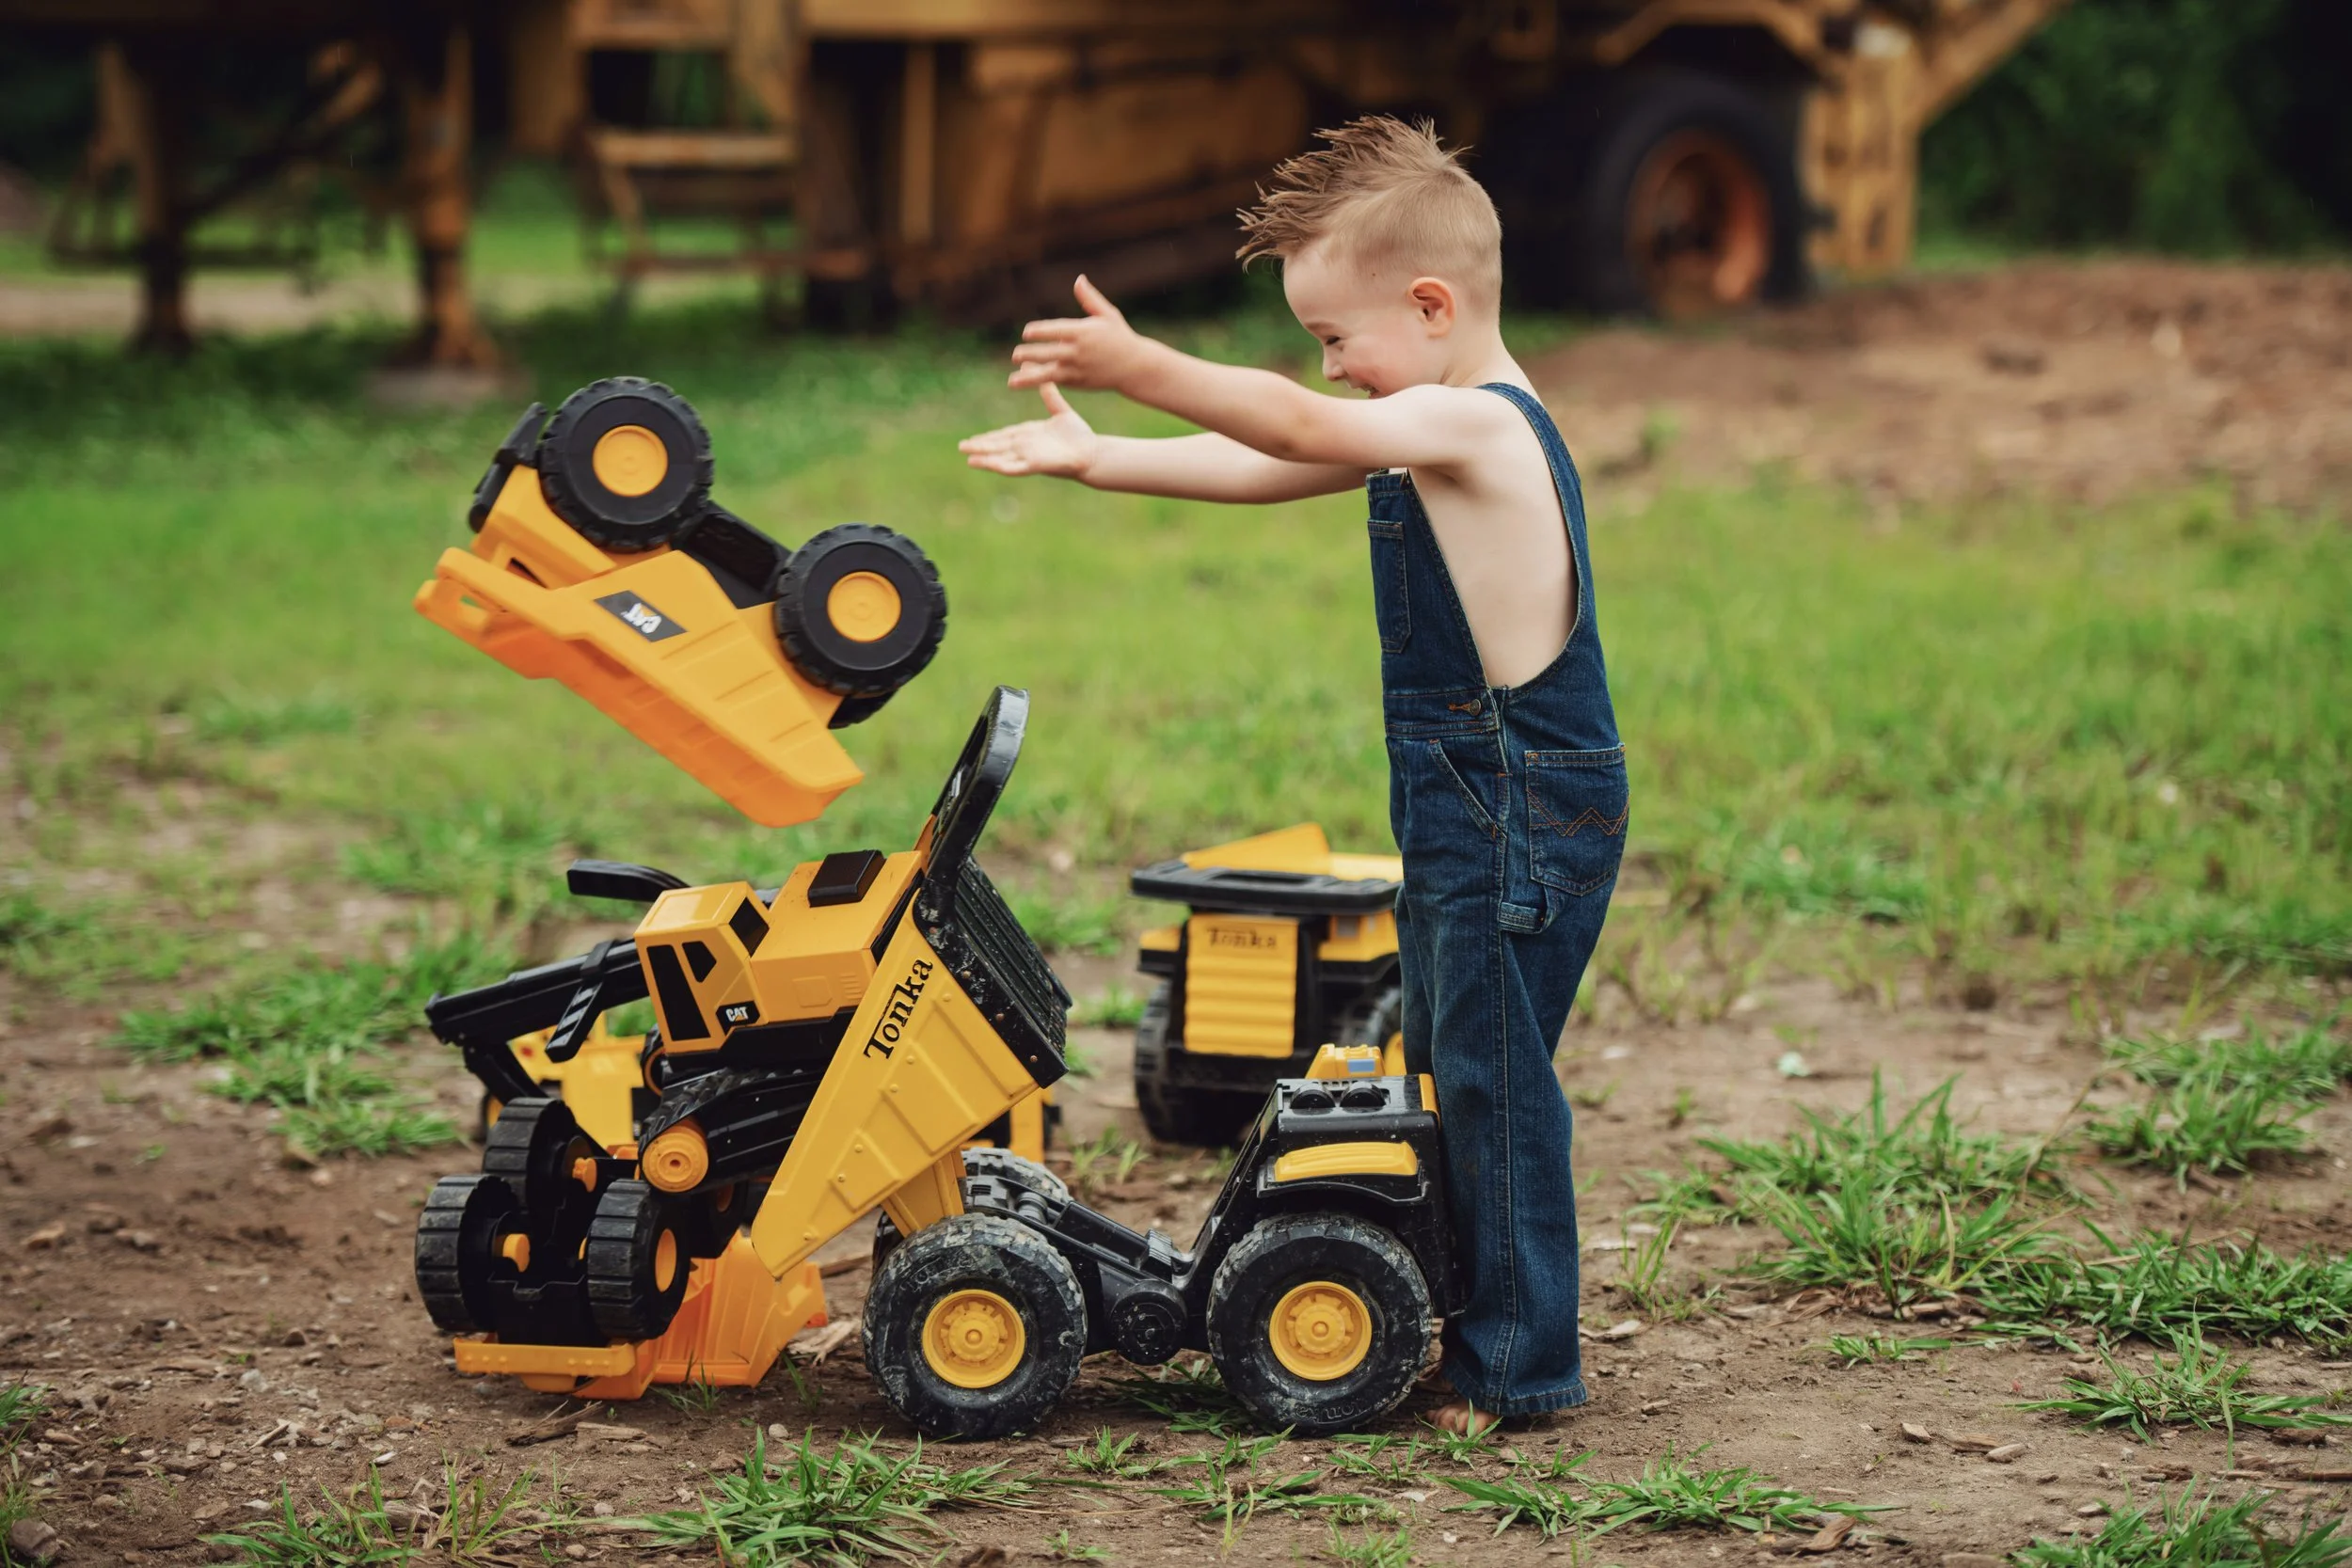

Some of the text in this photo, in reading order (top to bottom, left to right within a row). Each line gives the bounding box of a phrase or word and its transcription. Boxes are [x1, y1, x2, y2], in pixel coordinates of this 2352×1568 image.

[1206, 927, 1278, 949] Tonka
[725, 1006, 749, 1022] CAT
[863, 958, 933, 1059] Tonka
